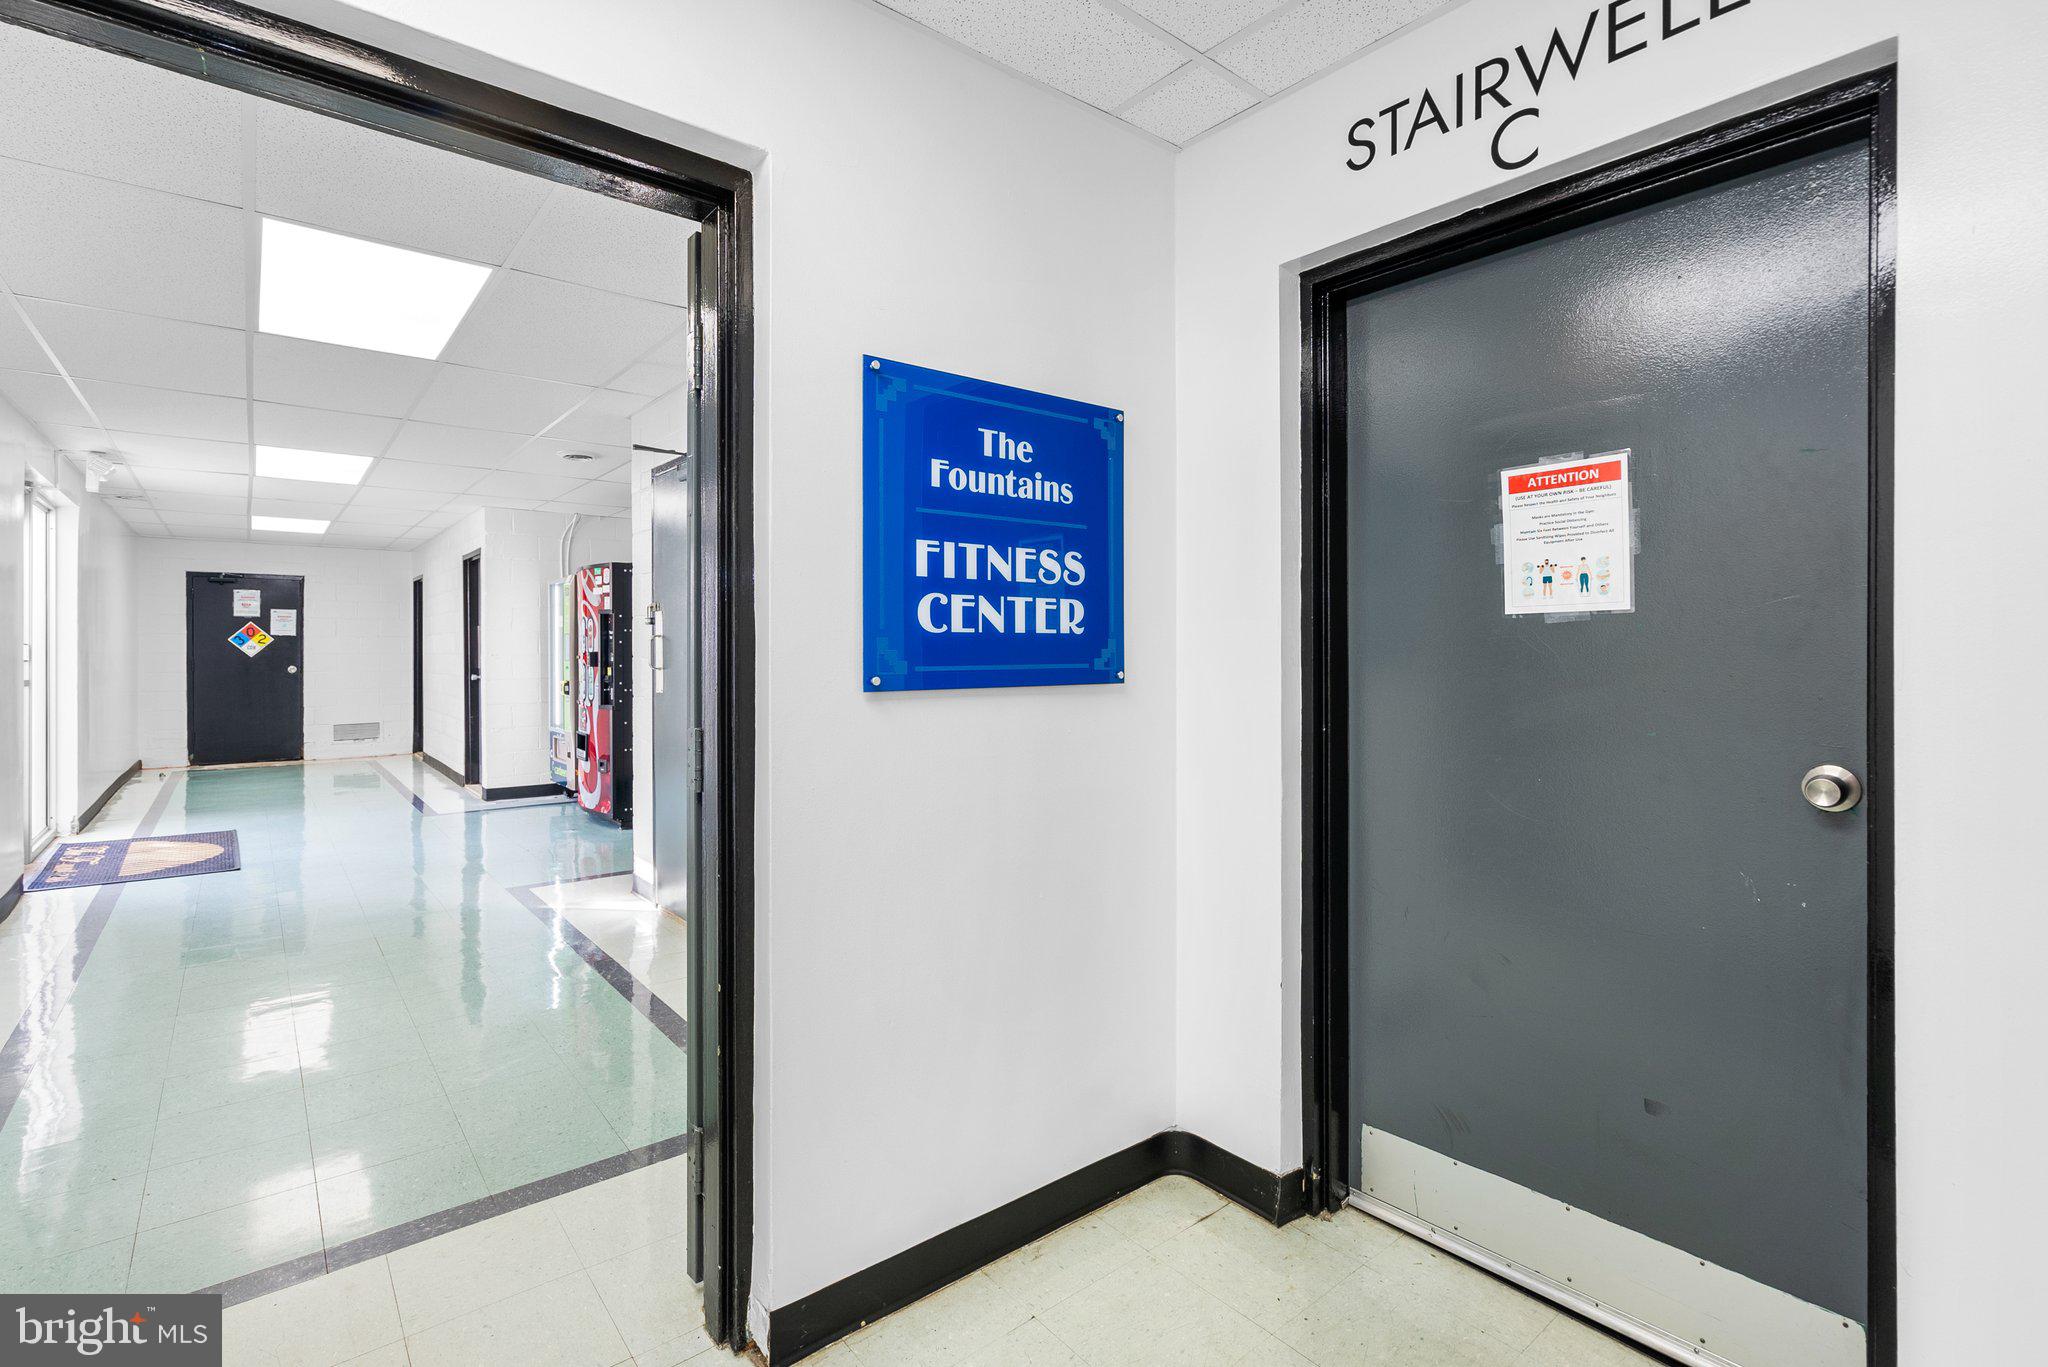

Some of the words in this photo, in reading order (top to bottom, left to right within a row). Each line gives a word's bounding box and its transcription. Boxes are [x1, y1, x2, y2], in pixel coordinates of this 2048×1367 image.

[1490, 107, 1540, 170] C
[978, 427, 1034, 464] The
[930, 458, 1074, 505] Fountains
[1528, 468, 1599, 488] ATTENTION
[915, 539, 1086, 586] FITNESS
[917, 591, 1086, 635] CENTER
[234, 636, 244, 646] 3
[258, 634, 266, 645] 2
